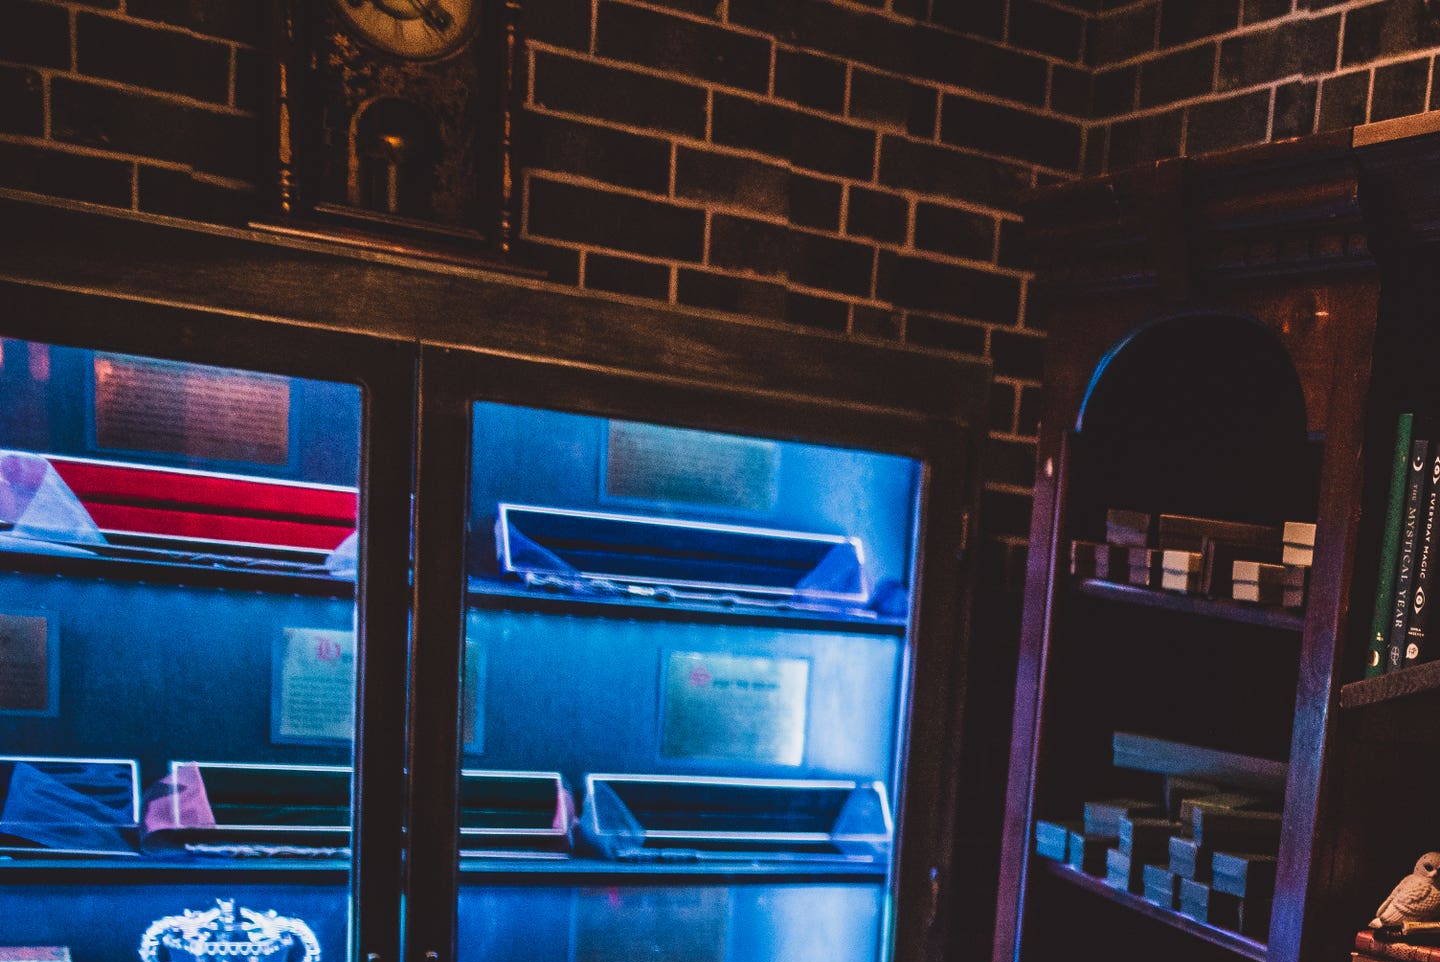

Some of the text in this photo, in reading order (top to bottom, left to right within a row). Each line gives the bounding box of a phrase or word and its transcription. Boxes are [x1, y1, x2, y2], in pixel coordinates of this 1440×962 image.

[1400, 506, 1417, 582] MYSTICAL
[1420, 492, 1437, 579] EVERYDAY MAGIC
[1395, 589, 1407, 628] YEAR
